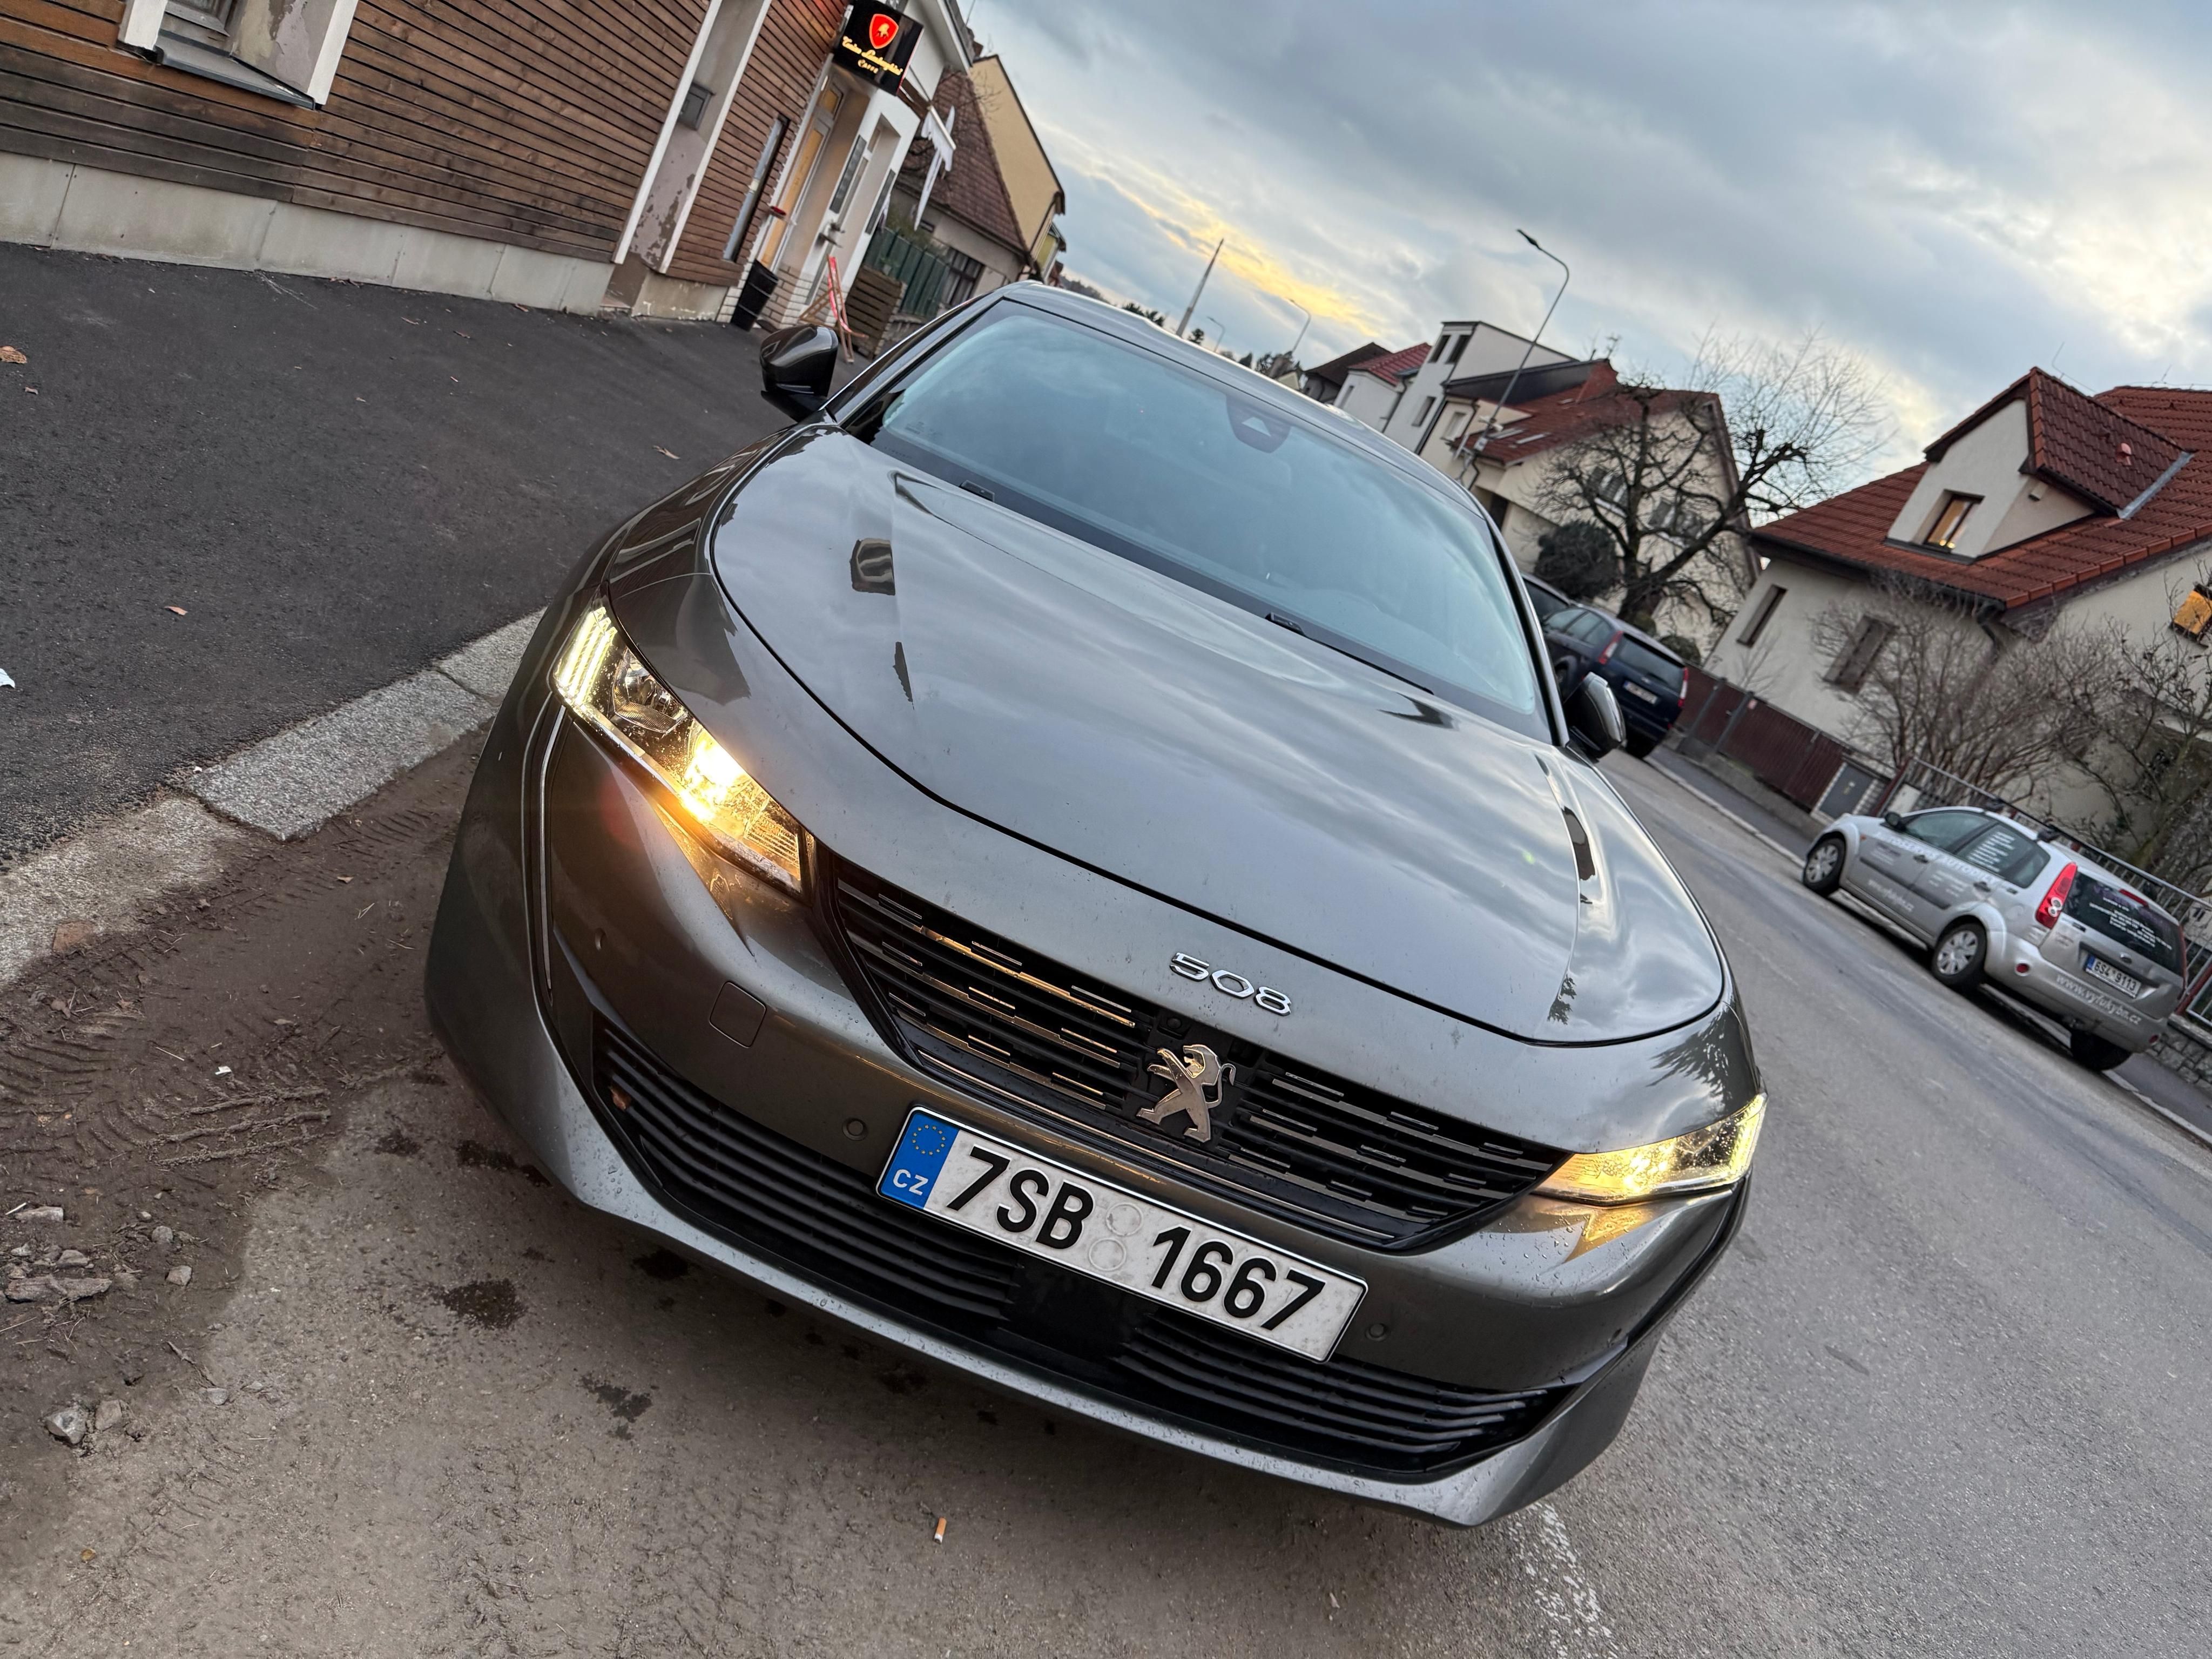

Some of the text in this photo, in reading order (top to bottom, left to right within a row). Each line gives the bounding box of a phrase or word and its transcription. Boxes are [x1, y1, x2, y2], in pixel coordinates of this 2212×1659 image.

[1170, 952, 1291, 1016] 508
[893, 1169, 929, 1196] CZ
[946, 1144, 1326, 1331] 7SB 1667
